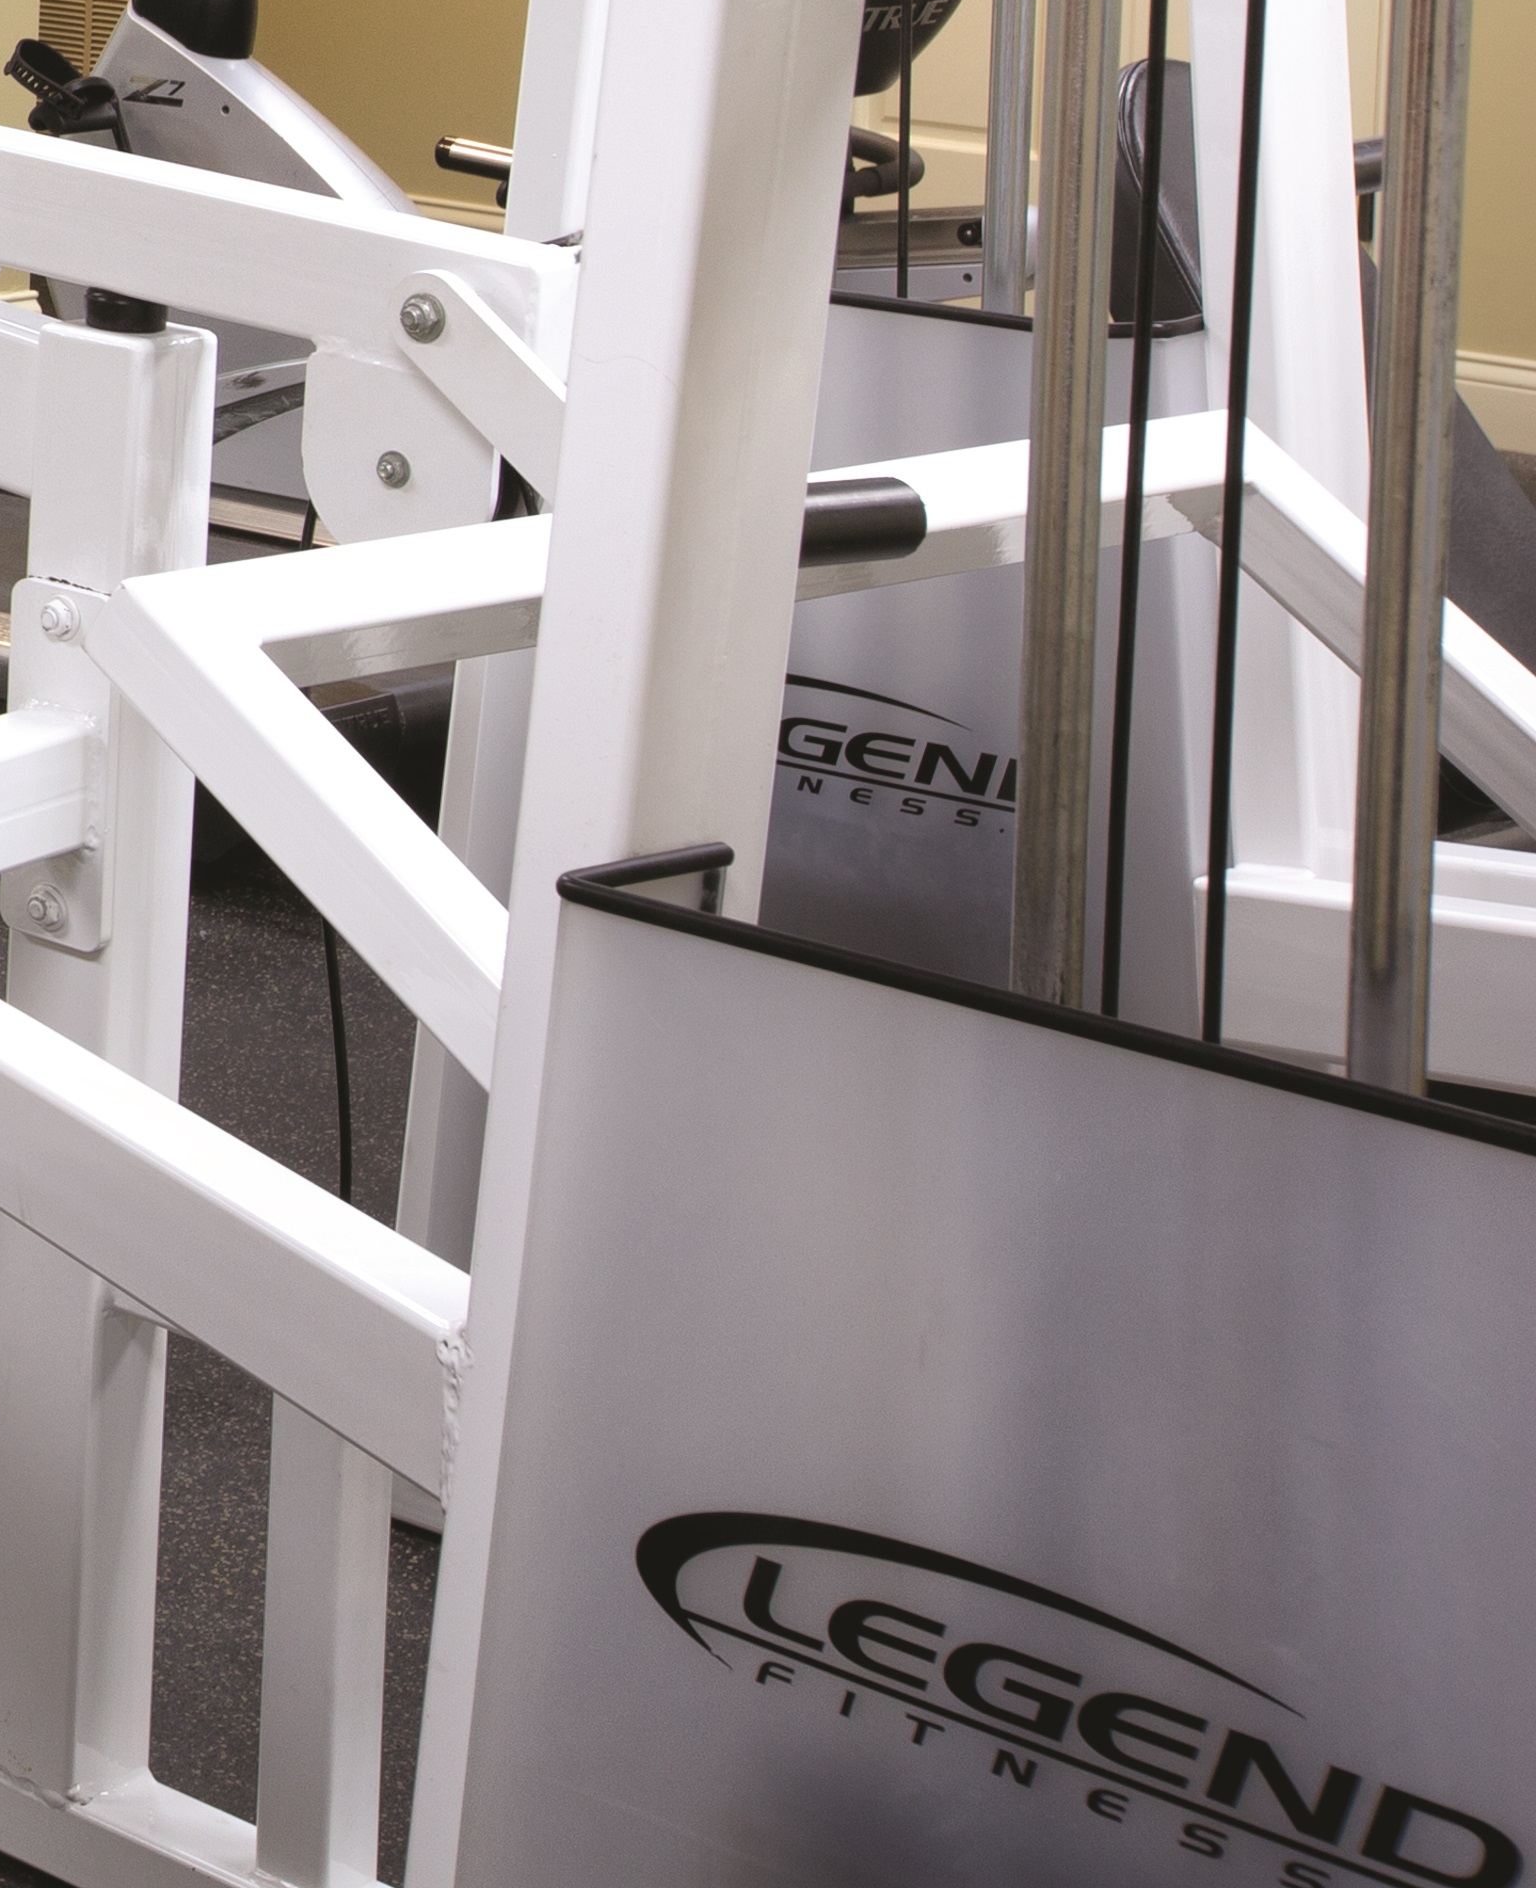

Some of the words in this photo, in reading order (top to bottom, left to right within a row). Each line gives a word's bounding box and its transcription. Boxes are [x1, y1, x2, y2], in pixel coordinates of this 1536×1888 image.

[778, 717, 1017, 802] GEN
[743, 1556, 1523, 1888] LEGEND
[756, 1661, 1330, 1888] FITNESS
